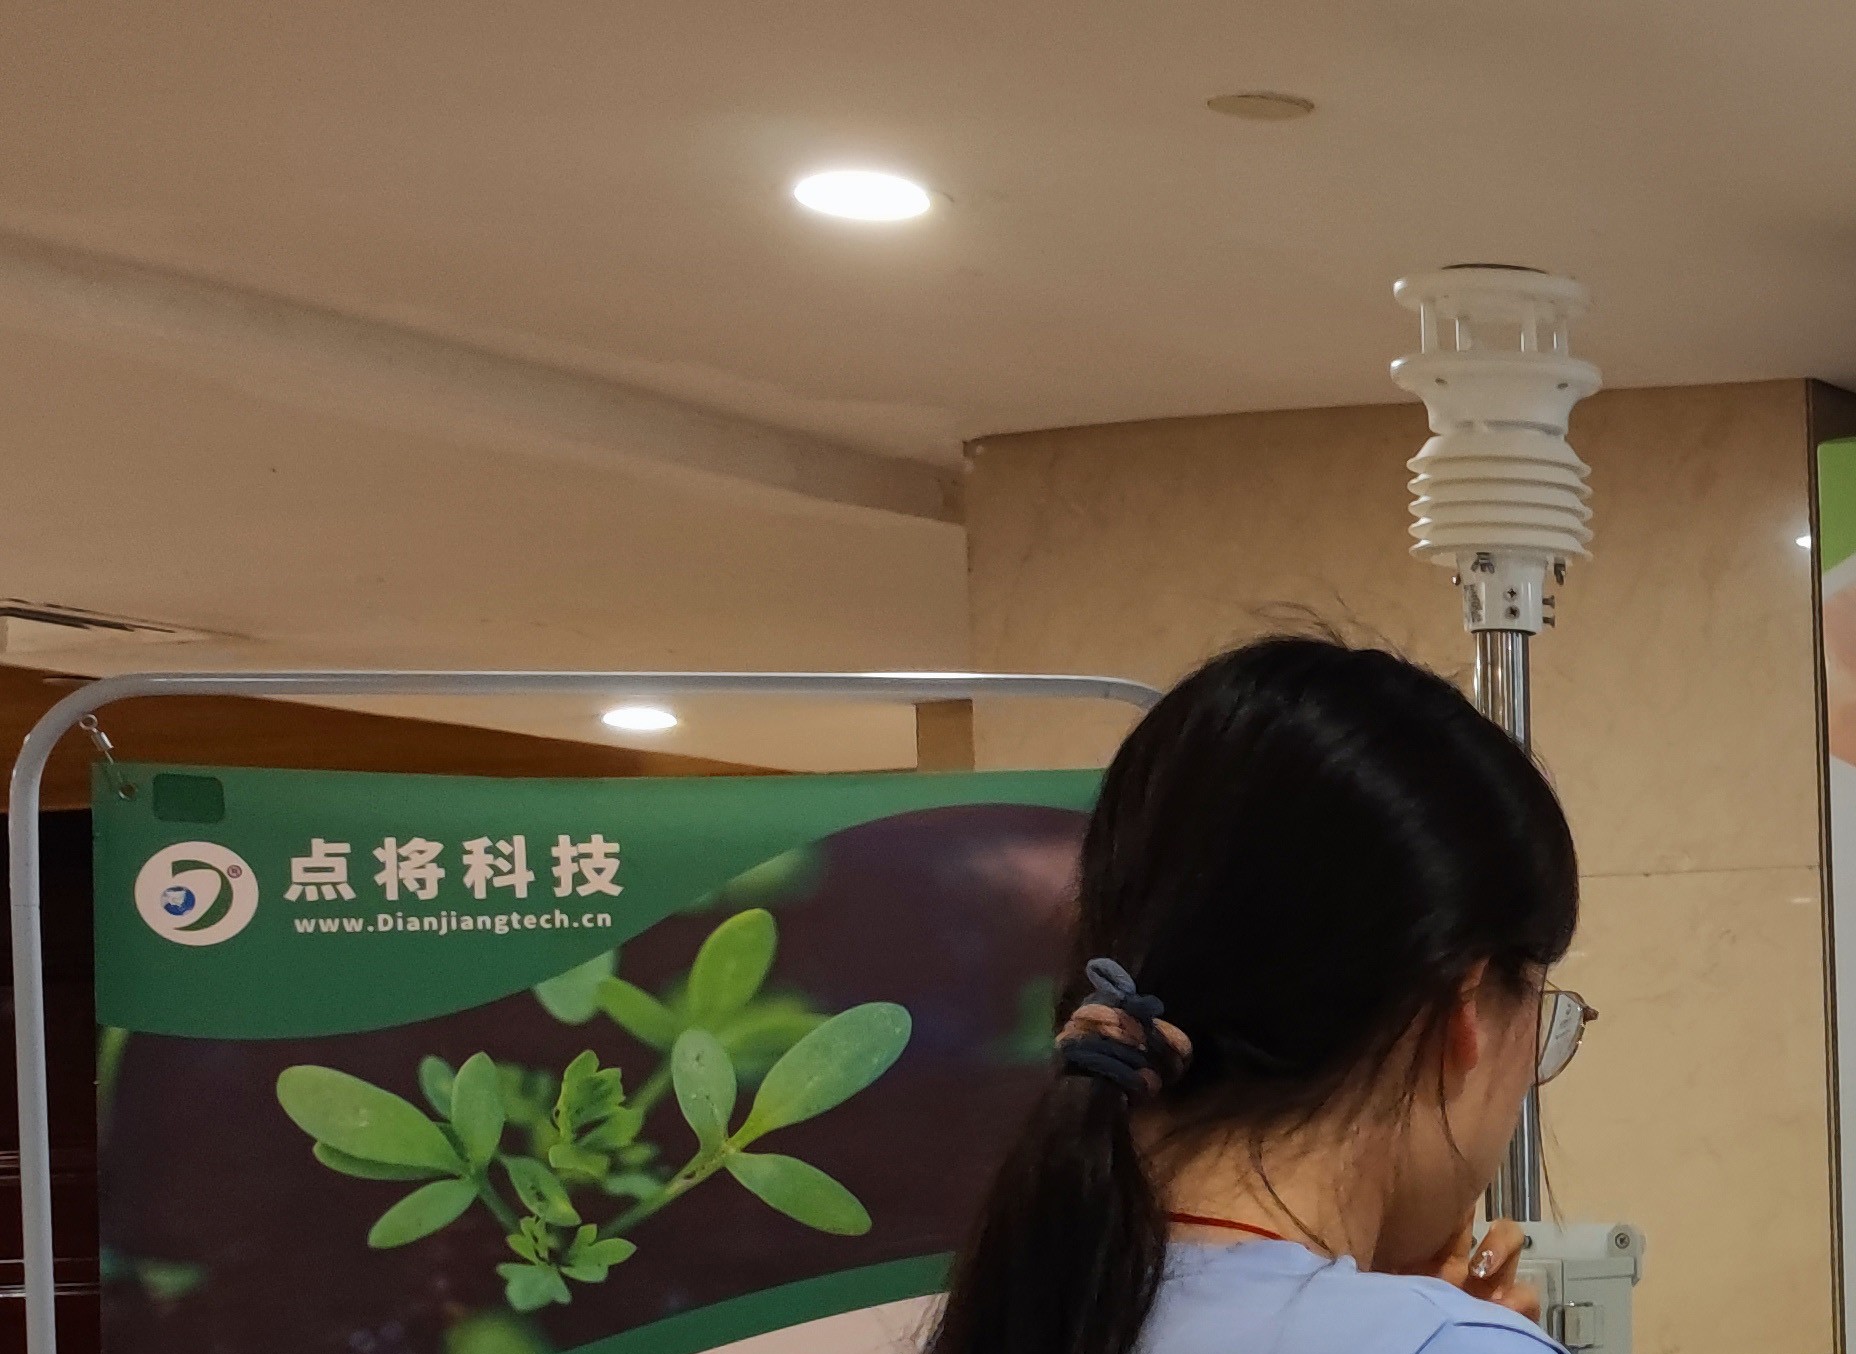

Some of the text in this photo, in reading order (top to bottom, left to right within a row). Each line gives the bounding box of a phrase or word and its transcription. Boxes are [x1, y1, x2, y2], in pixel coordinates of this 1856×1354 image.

[283, 834, 626, 902] 点将科技
[294, 909, 612, 935] www.Dianjiangtech.cn
